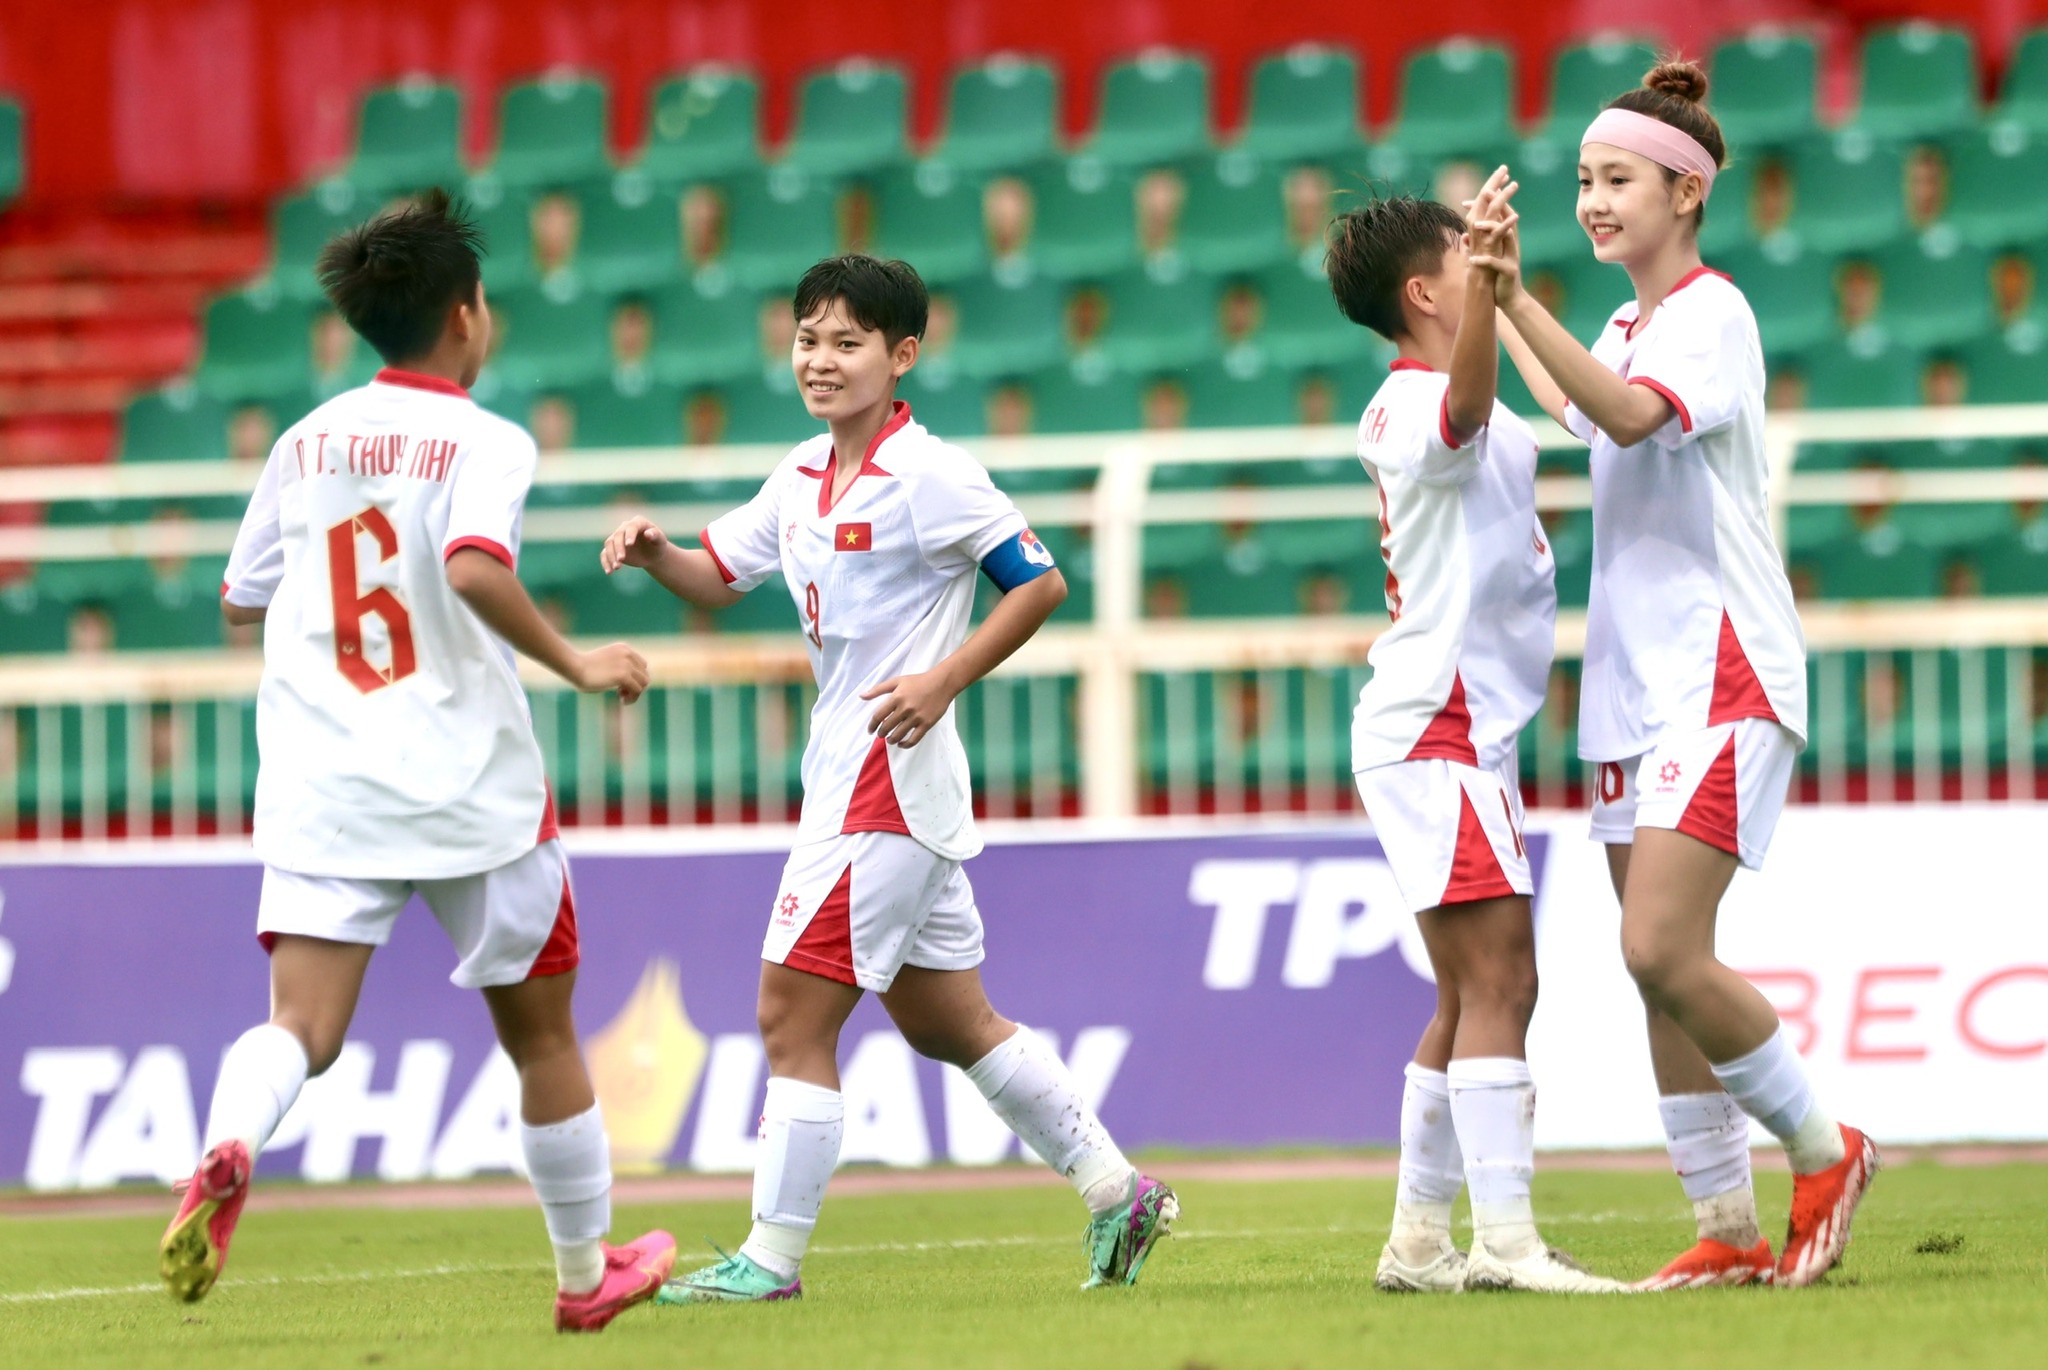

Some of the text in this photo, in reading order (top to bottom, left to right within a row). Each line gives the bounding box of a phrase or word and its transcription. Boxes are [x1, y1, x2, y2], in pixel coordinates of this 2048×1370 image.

[327, 507, 416, 694] 6
[806, 581, 823, 651] 9
[1188, 858, 1437, 990] TP
